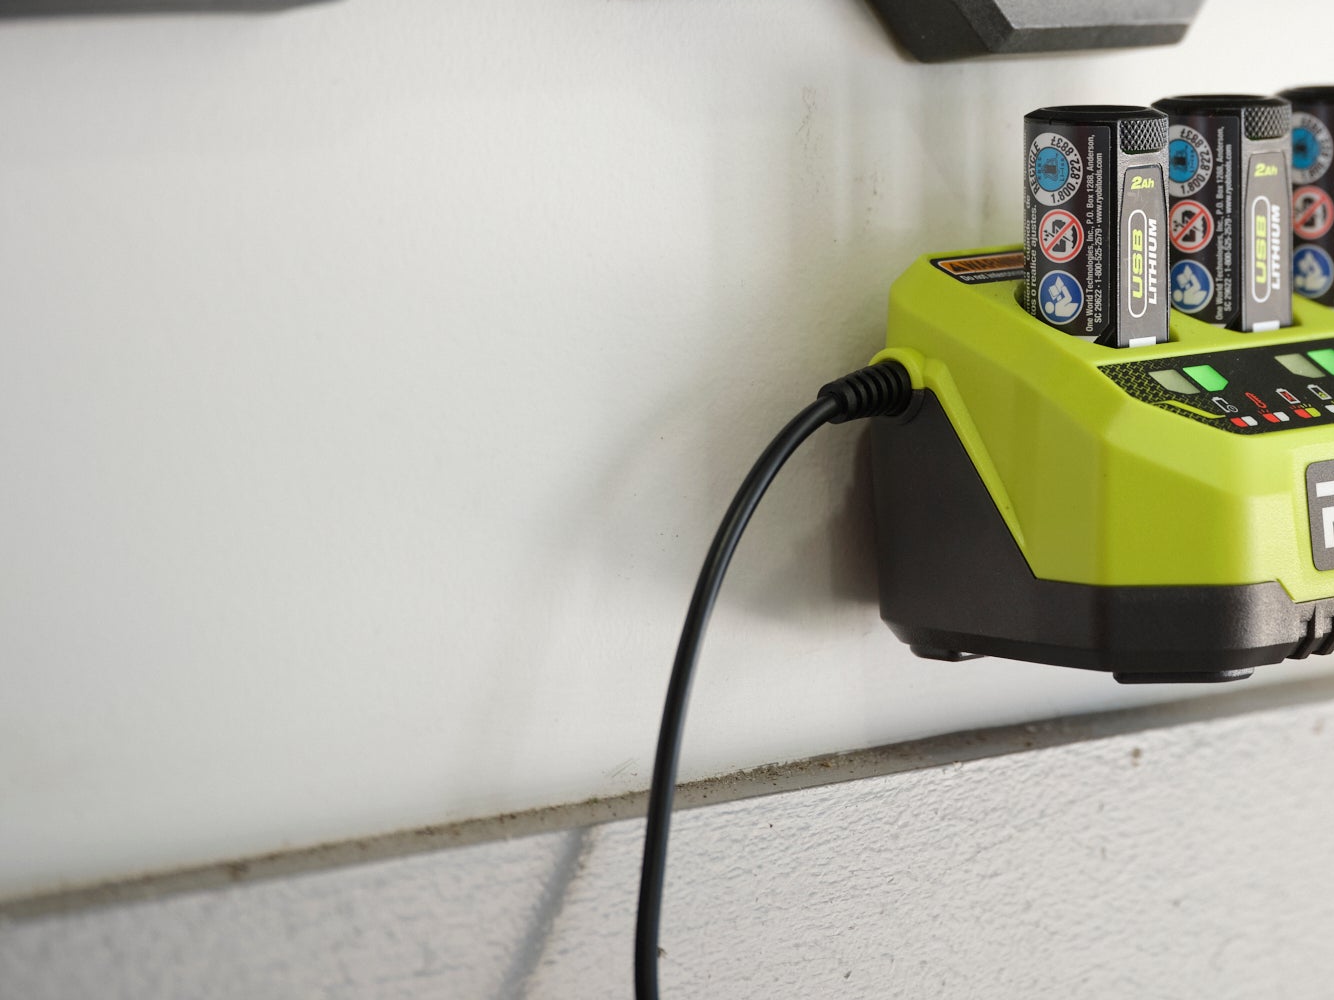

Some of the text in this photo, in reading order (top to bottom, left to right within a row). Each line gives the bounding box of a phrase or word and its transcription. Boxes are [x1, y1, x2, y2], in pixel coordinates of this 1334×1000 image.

[1029, 141, 1041, 195] RECYCLE
[1051, 136, 1081, 204] 1.800.822.8837
[1131, 176, 1154, 190] 2Ah
[1254, 163, 1278, 177] 2Ah
[1030, 205, 1038, 247] ajustes.
[1086, 134, 1096, 332] One World Technologies, Inc., P.O. Box 1288, Anderson,
[1094, 152, 1103, 323] SC 29622 1-800-525-2579 www.ryobitools.com
[1256, 215, 1267, 284] USB
[1272, 204, 1280, 290] LITHIUM
[1132, 228, 1143, 298] USB
[1148, 218, 1157, 305] LITHIUM
